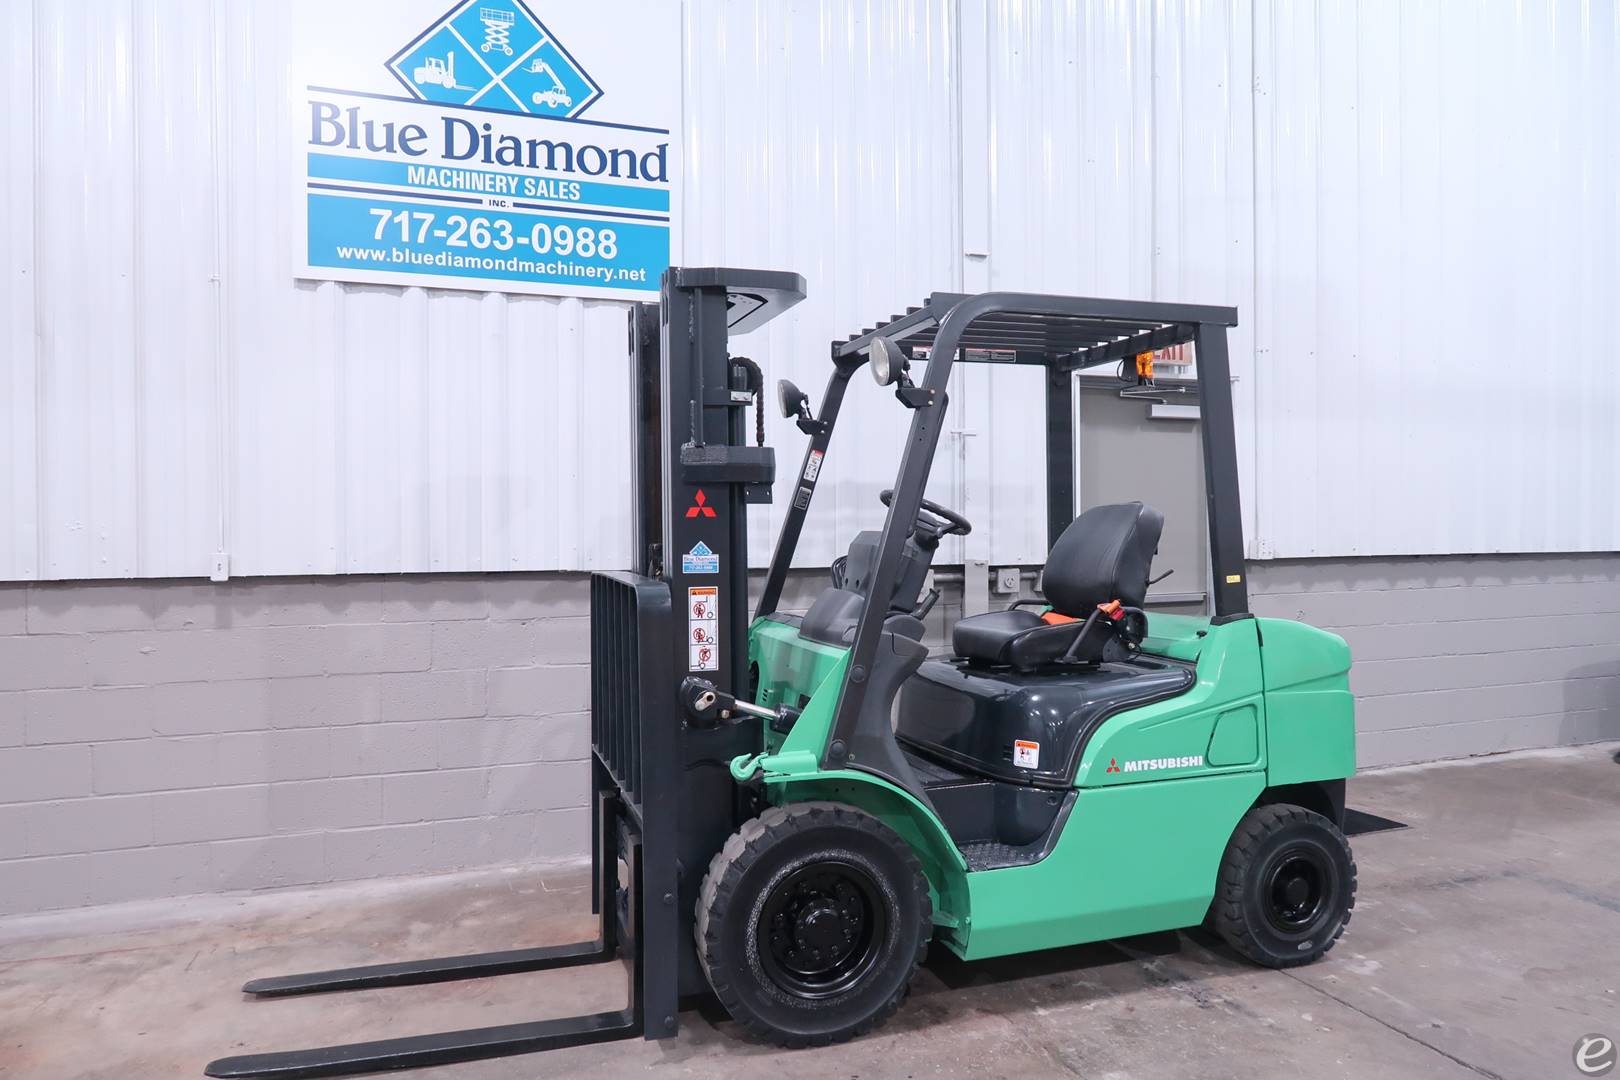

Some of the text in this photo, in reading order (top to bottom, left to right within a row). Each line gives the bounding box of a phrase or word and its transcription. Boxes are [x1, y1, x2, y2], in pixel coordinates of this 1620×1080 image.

[308, 100, 670, 183] Blue Diamond
[407, 165, 581, 201] MACHINERY SALES
[488, 199, 510, 208] INC.
[369, 208, 618, 260] 717-263-0988
[336, 244, 647, 282] www.bluediamondmachinery.net
[1124, 755, 1203, 773] MITSUBISHI
